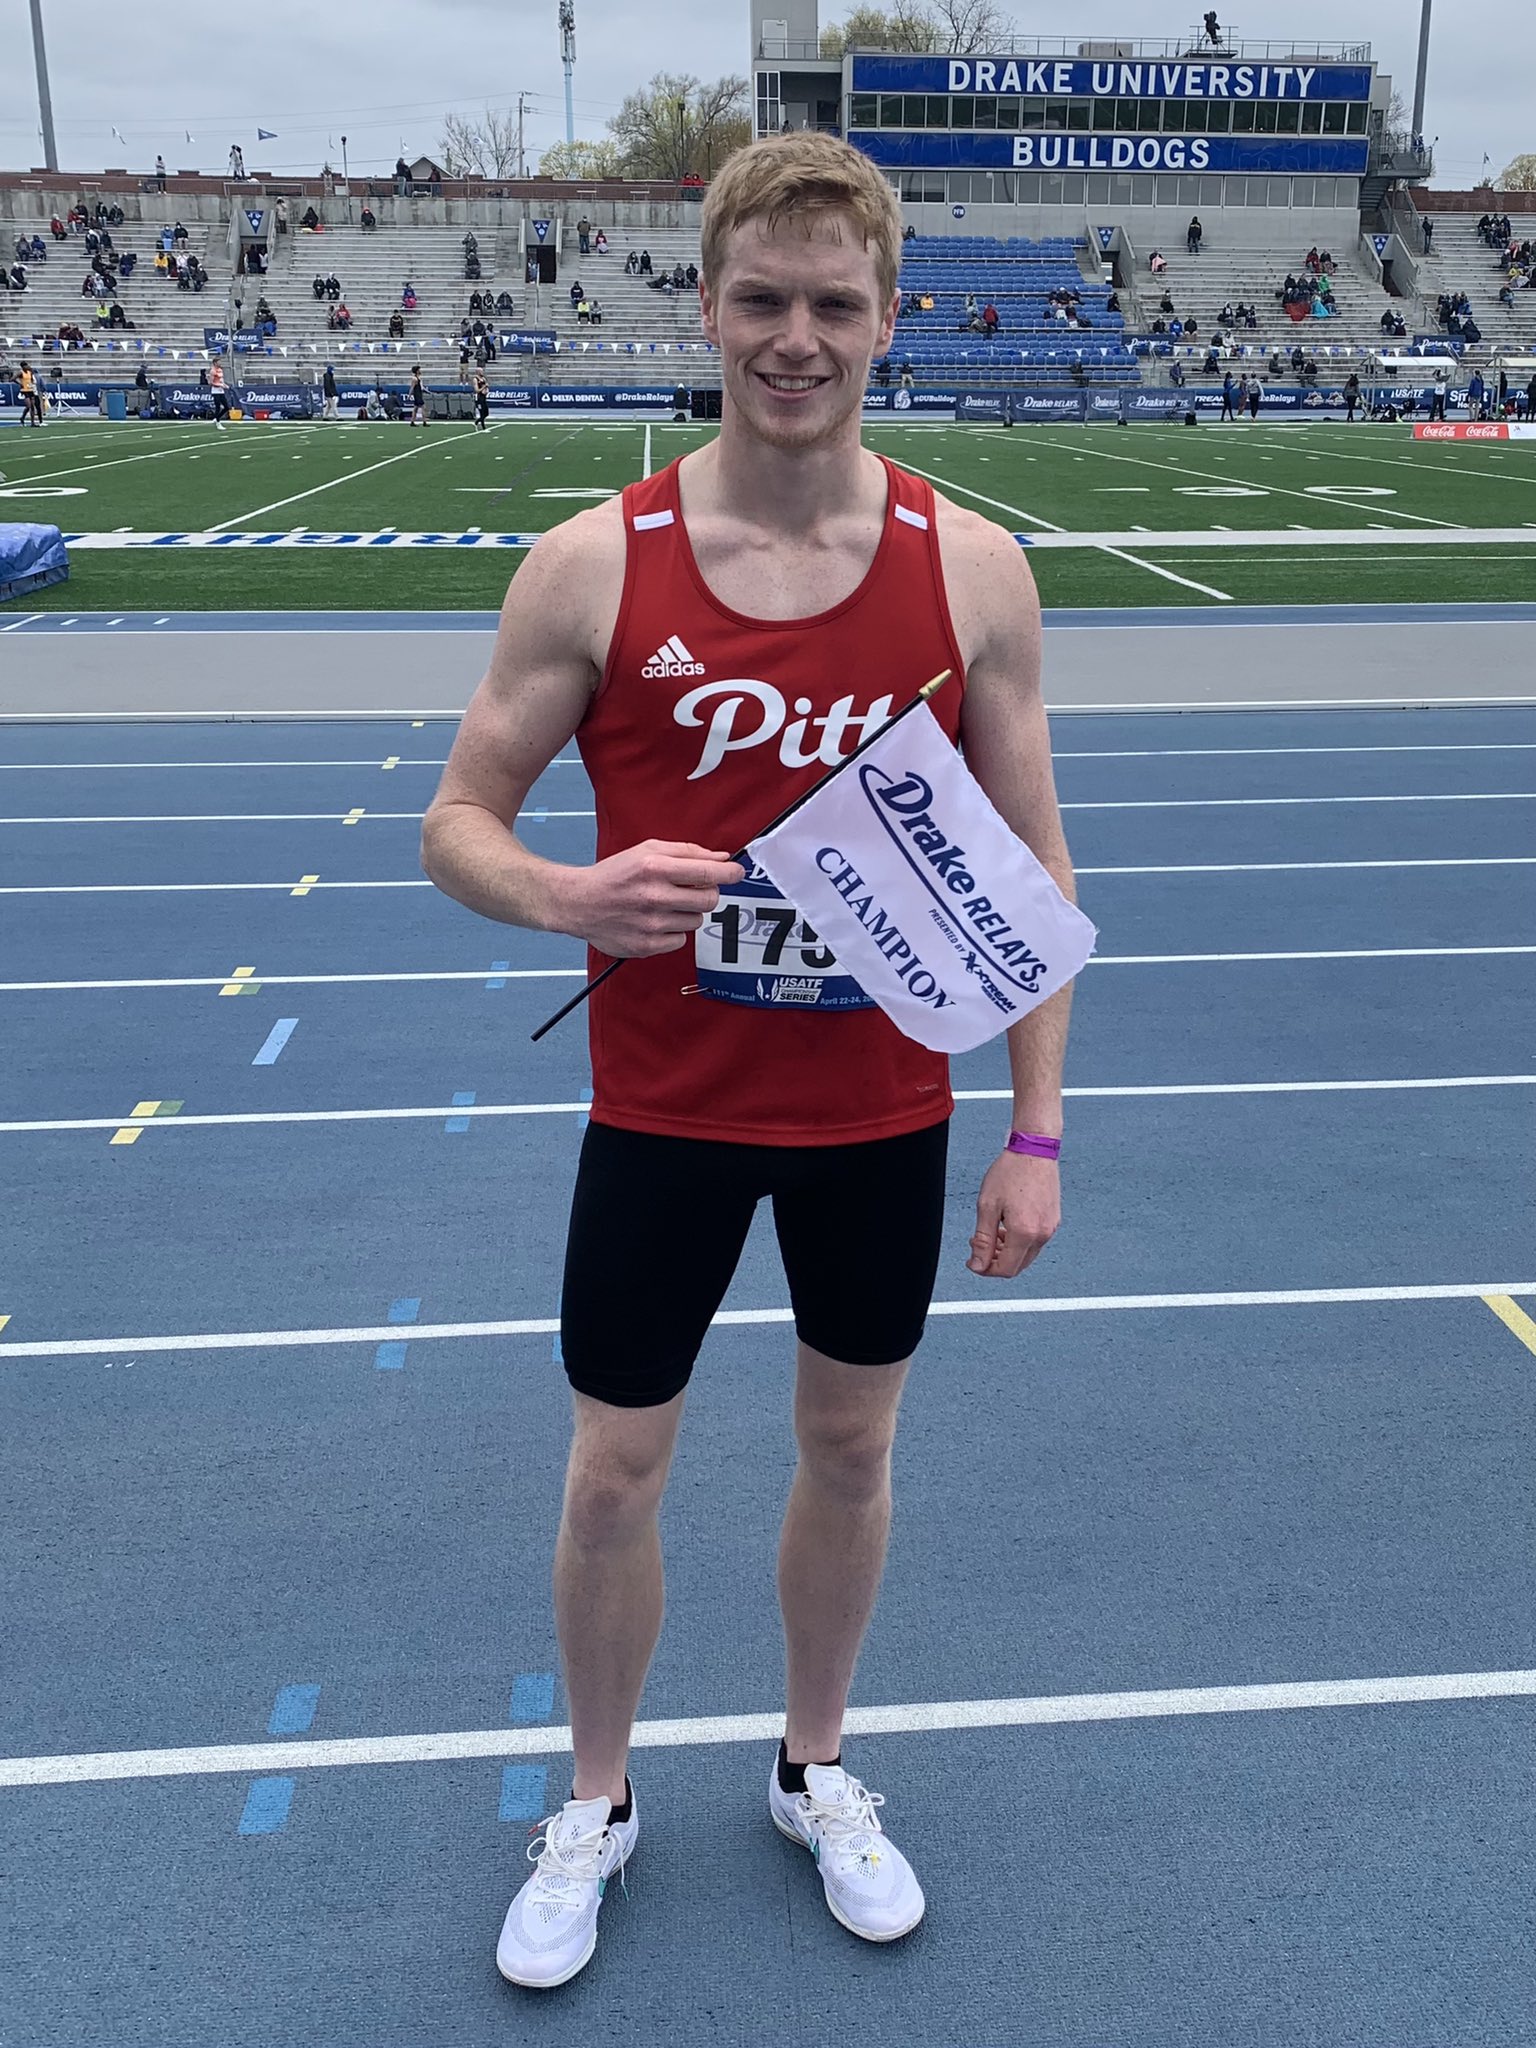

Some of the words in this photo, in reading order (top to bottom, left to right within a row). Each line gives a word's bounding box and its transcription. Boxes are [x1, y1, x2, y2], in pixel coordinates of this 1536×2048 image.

[948, 60, 1073, 94] DRAKE
[1091, 64, 1316, 98] UNIVERSITY
[1012, 136, 1210, 169] BULLDOGS
[215, 332, 238, 341] Drae
[55, 392, 87, 400] DENTAL
[173, 390, 200, 401] Drake
[246, 391, 275, 402] Drake
[486, 390, 505, 398] rake
[552, 394, 575, 402] DELTA
[576, 394, 604, 402] DENTAL
[615, 393, 674, 402] @DrakeRelays
[1023, 396, 1053, 408] Drake
[1054, 400, 1078, 408] RELAYS
[1136, 396, 1165, 407] Drake
[641, 660, 705, 679] adidas
[673, 678, 893, 781] Pitt
[876, 771, 975, 895] Drake
[961, 896, 1048, 982] RELAYS
[815, 847, 956, 1010] CHAMPION
[929, 908, 959, 944] PRESENTED
[954, 940, 966, 952] BY
[779, 977, 824, 989] USATF
[730, 991, 756, 1002] Annual
[779, 993, 816, 1002] SERIES
[820, 996, 838, 1006] April
